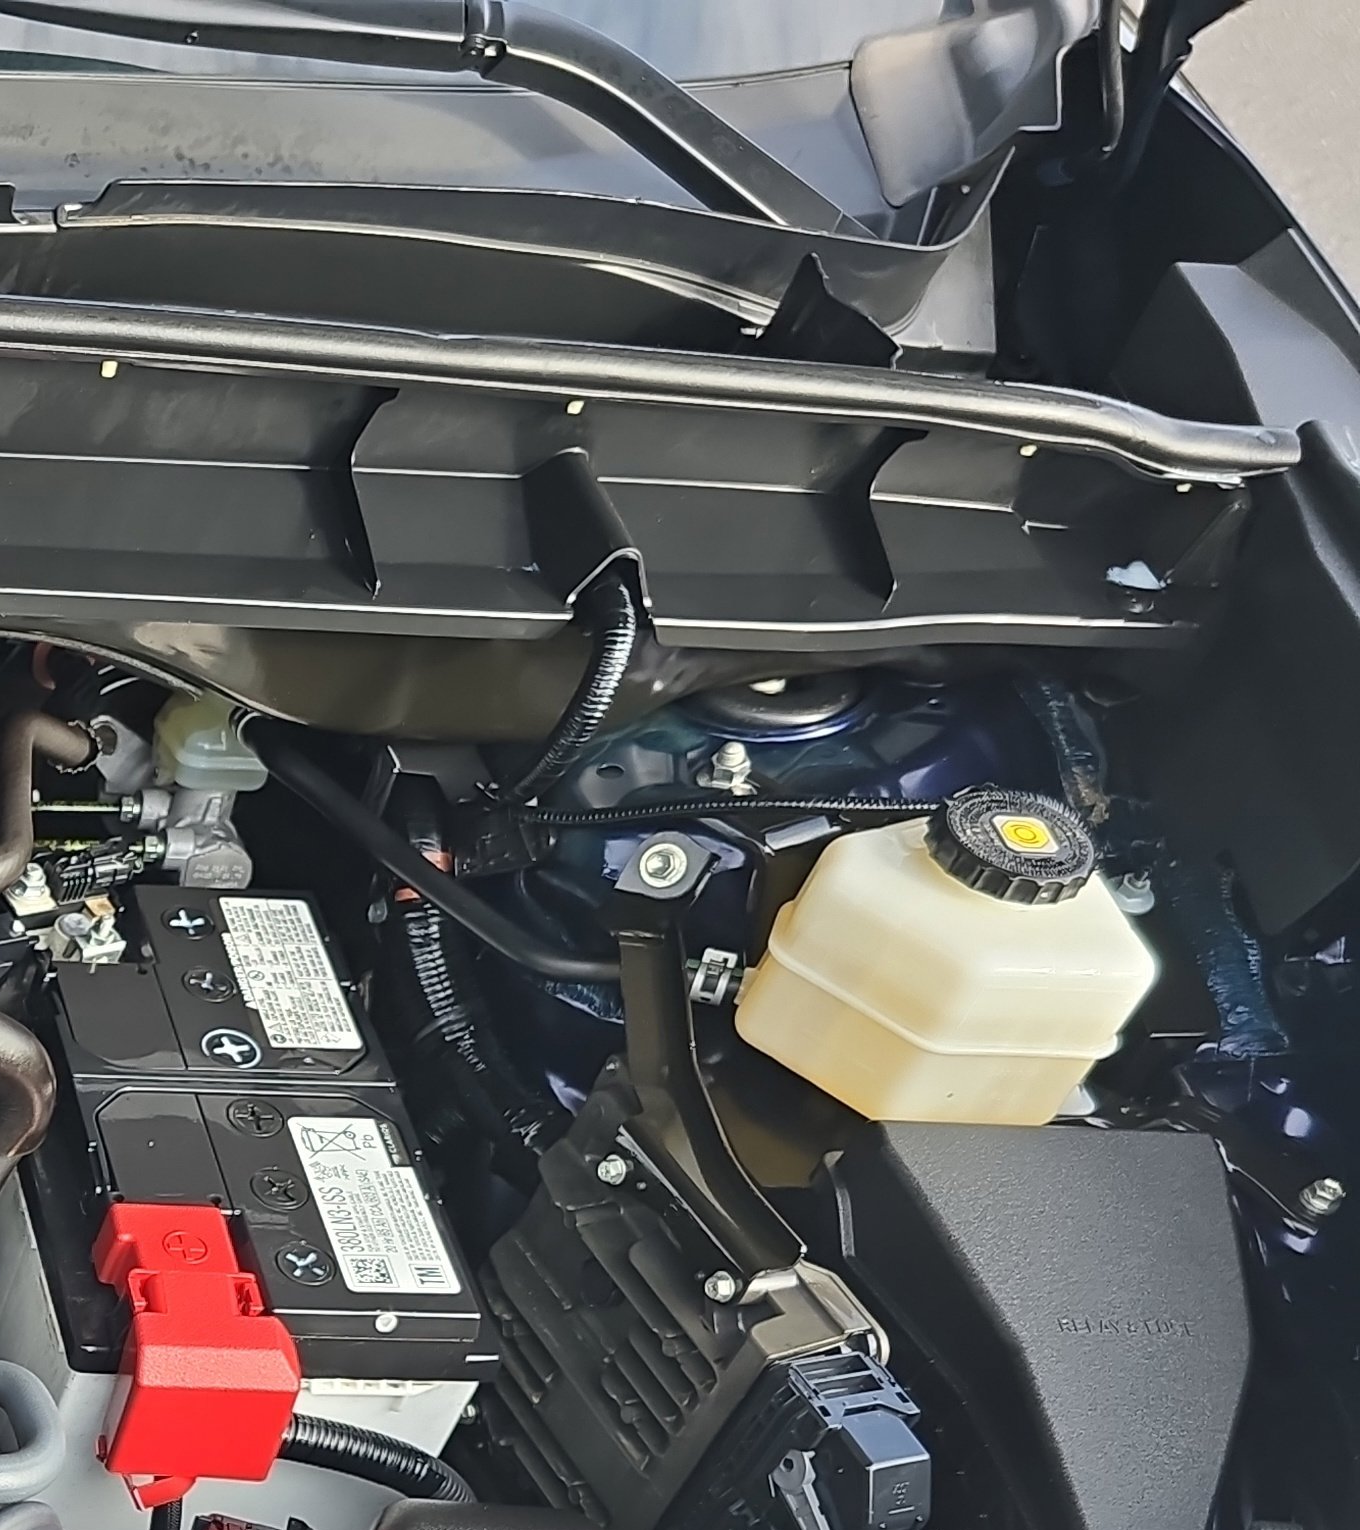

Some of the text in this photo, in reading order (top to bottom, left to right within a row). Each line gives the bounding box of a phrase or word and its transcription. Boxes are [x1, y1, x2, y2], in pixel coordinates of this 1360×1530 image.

[362, 1134, 377, 1149] Pb
[318, 1186, 365, 1252] 380LN3-ISS
[414, 1266, 446, 1285] TM
